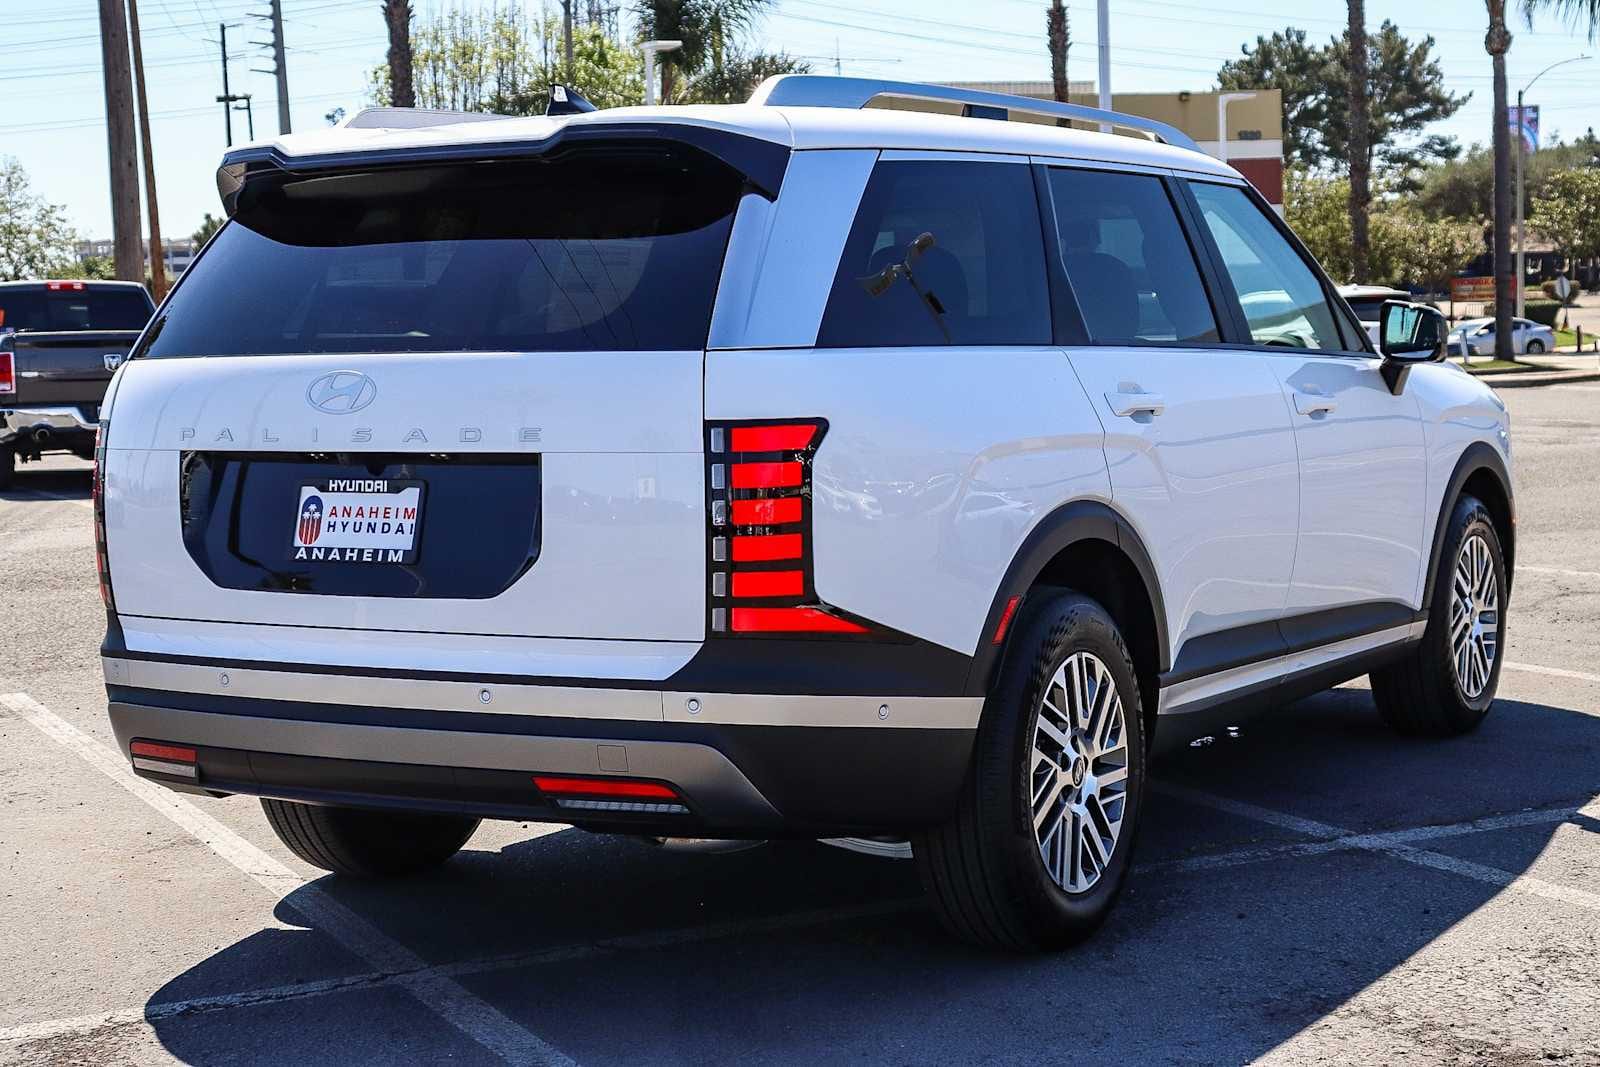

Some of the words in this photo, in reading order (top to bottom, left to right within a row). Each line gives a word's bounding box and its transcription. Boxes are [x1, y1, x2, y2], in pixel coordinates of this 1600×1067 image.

[179, 427, 542, 443] PALISADE
[328, 479, 388, 493] HYUNDAI
[328, 506, 416, 520] ANAHEIM
[326, 521, 414, 535] HYUNDAI
[294, 547, 404, 562] ANAHEIM
